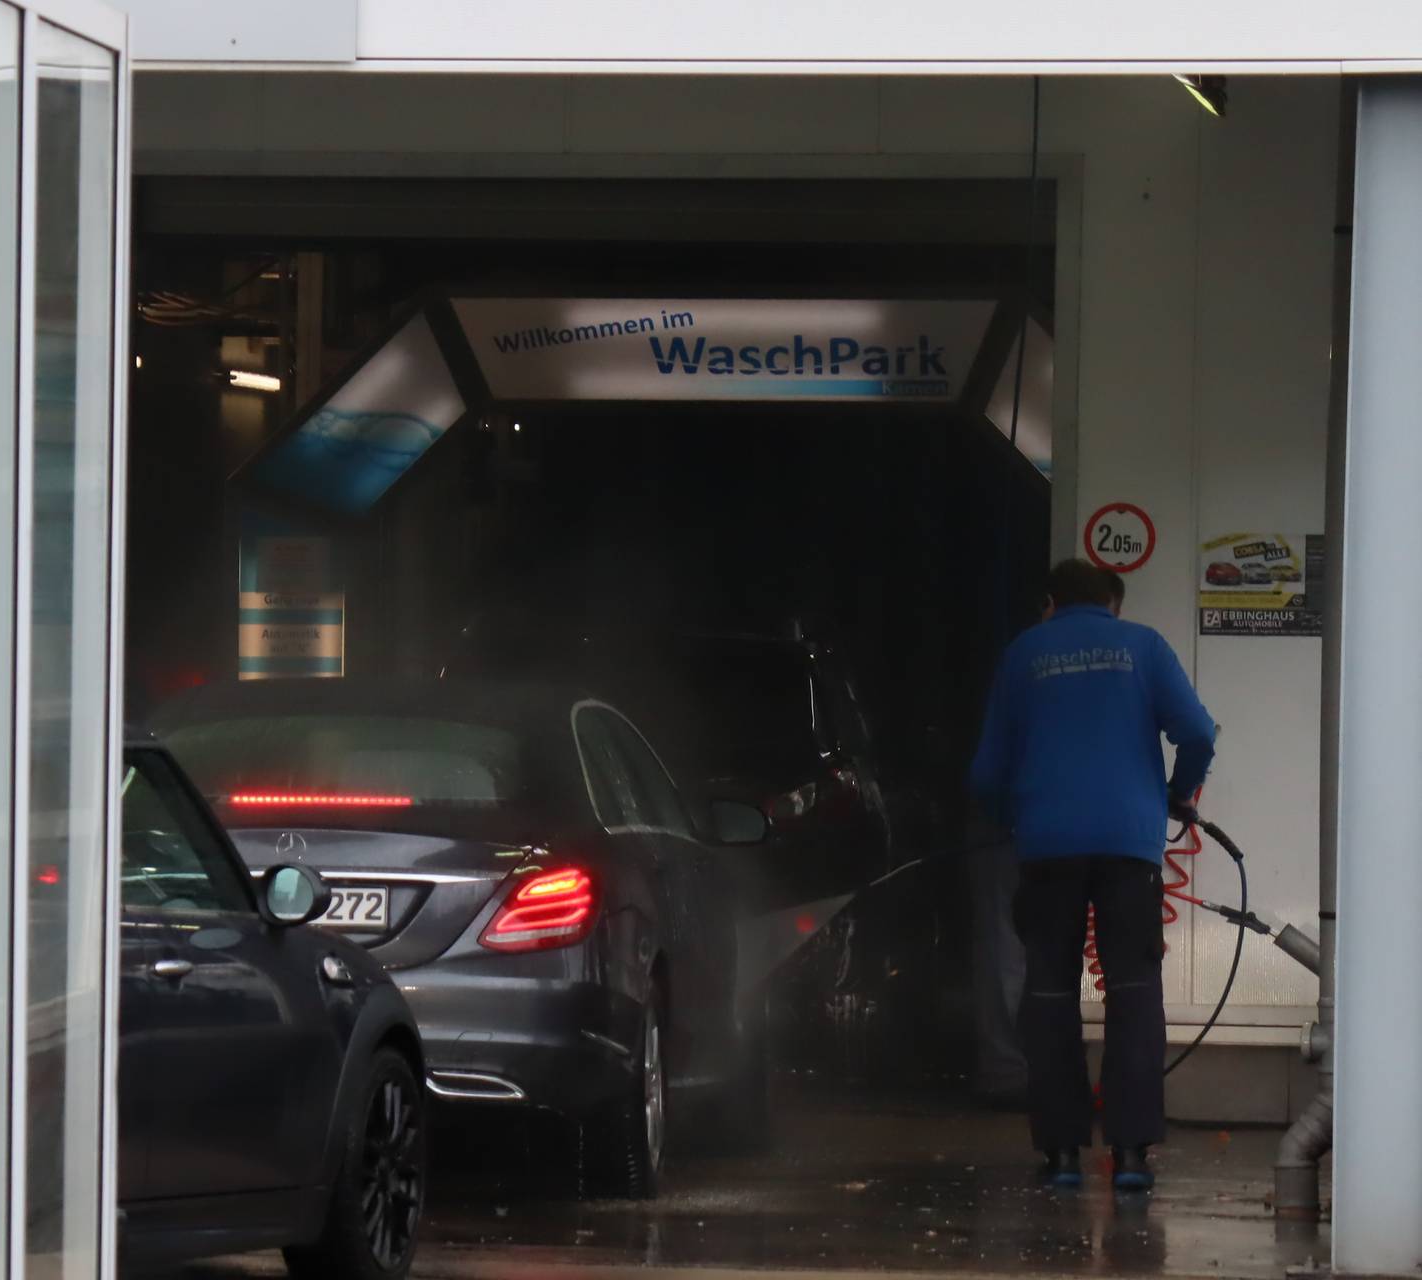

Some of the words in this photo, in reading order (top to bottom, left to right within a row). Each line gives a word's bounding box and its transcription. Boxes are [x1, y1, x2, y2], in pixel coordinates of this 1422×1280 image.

[492, 316, 655, 354] Willkommen
[661, 310, 695, 330] im
[649, 334, 947, 376] WaschPark
[1223, 611, 1295, 622] EBBINGHAUS
[1233, 620, 1283, 629] AUTOMOBILE
[1030, 647, 1134, 671] WaschPark
[326, 892, 383, 920] 272
